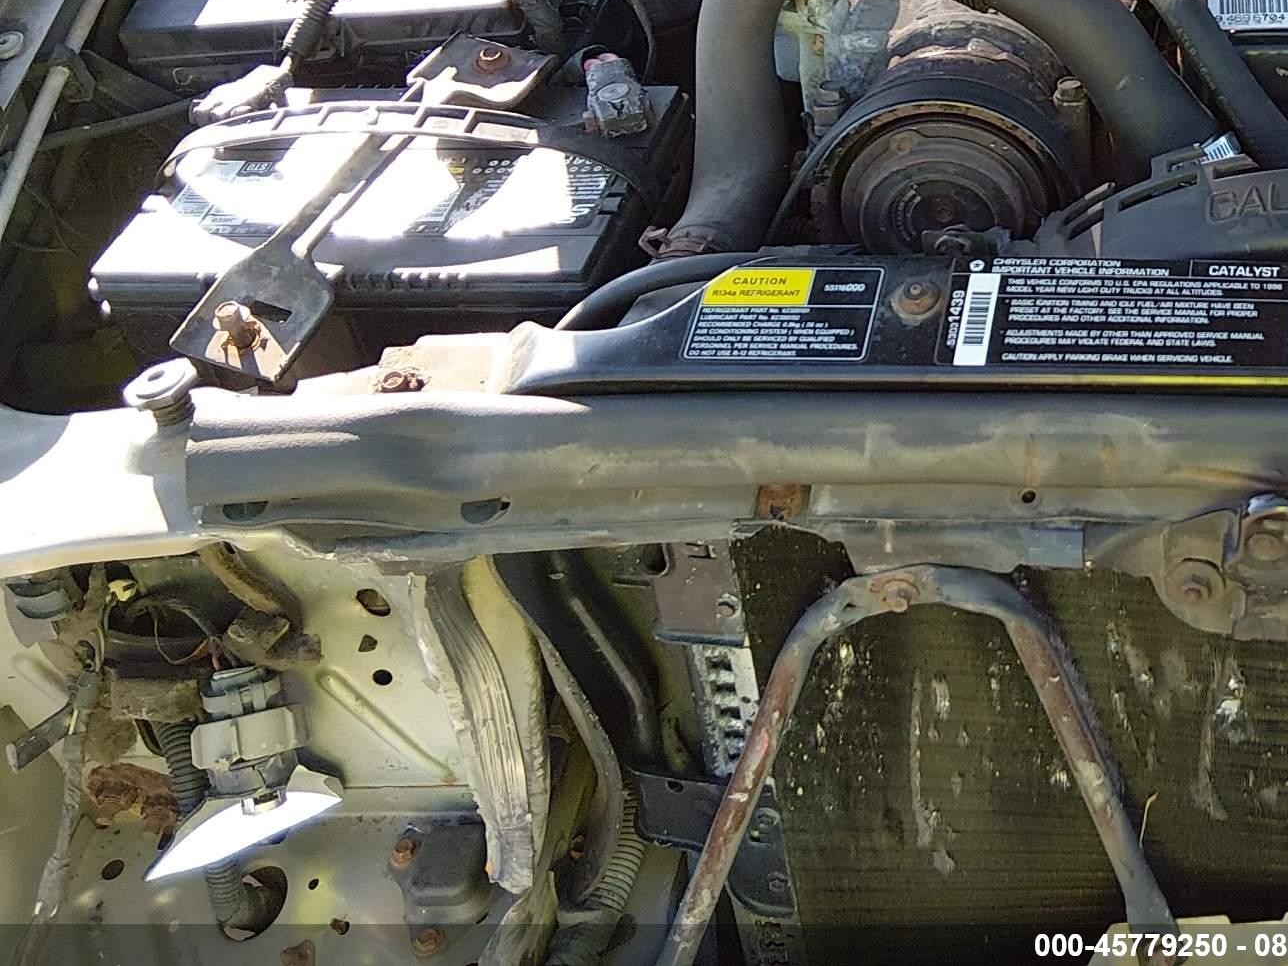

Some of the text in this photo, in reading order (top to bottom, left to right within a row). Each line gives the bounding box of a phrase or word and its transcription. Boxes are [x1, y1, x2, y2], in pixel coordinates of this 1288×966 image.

[992, 258, 1121, 267] CHRYSLER CORPORATION
[991, 266, 1053, 274] IMPORTANT
[1098, 267, 1170, 276] INFORMATION
[1208, 265, 1280, 277] CATALYST
[732, 277, 787, 285] CAUTION
[1026, 278, 1058, 286] VEHICLE
[1149, 280, 1202, 288] REGULATIONS
[1202, 281, 1248, 290] APPLICABLE
[738, 289, 801, 297] REFRIGERANT
[1005, 285, 1033, 293] MODEL
[1122, 287, 1153, 295] TRUCKS
[1174, 309, 1208, 317] MANUAL
[1226, 310, 1258, 318] PROPER
[1061, 314, 1080, 322] AND
[1107, 315, 1153, 323] ADDITIONAL
[1006, 329, 1064, 337] ADJUSTMENTS
[1102, 330, 1129, 338] OTHER
[1153, 331, 1194, 339] APPROVED
[1196, 331, 1229, 339] SERVICE
[1058, 337, 1077, 345] MAY
[1110, 338, 1145, 346] FEDERAL
[1146, 338, 1165, 346] AND
[1064, 353, 1101, 362] PARKING
[1101, 353, 1128, 362] BRAKE
[1129, 354, 1156, 362] WHEN
[1156, 354, 1199, 363] SERVICING
